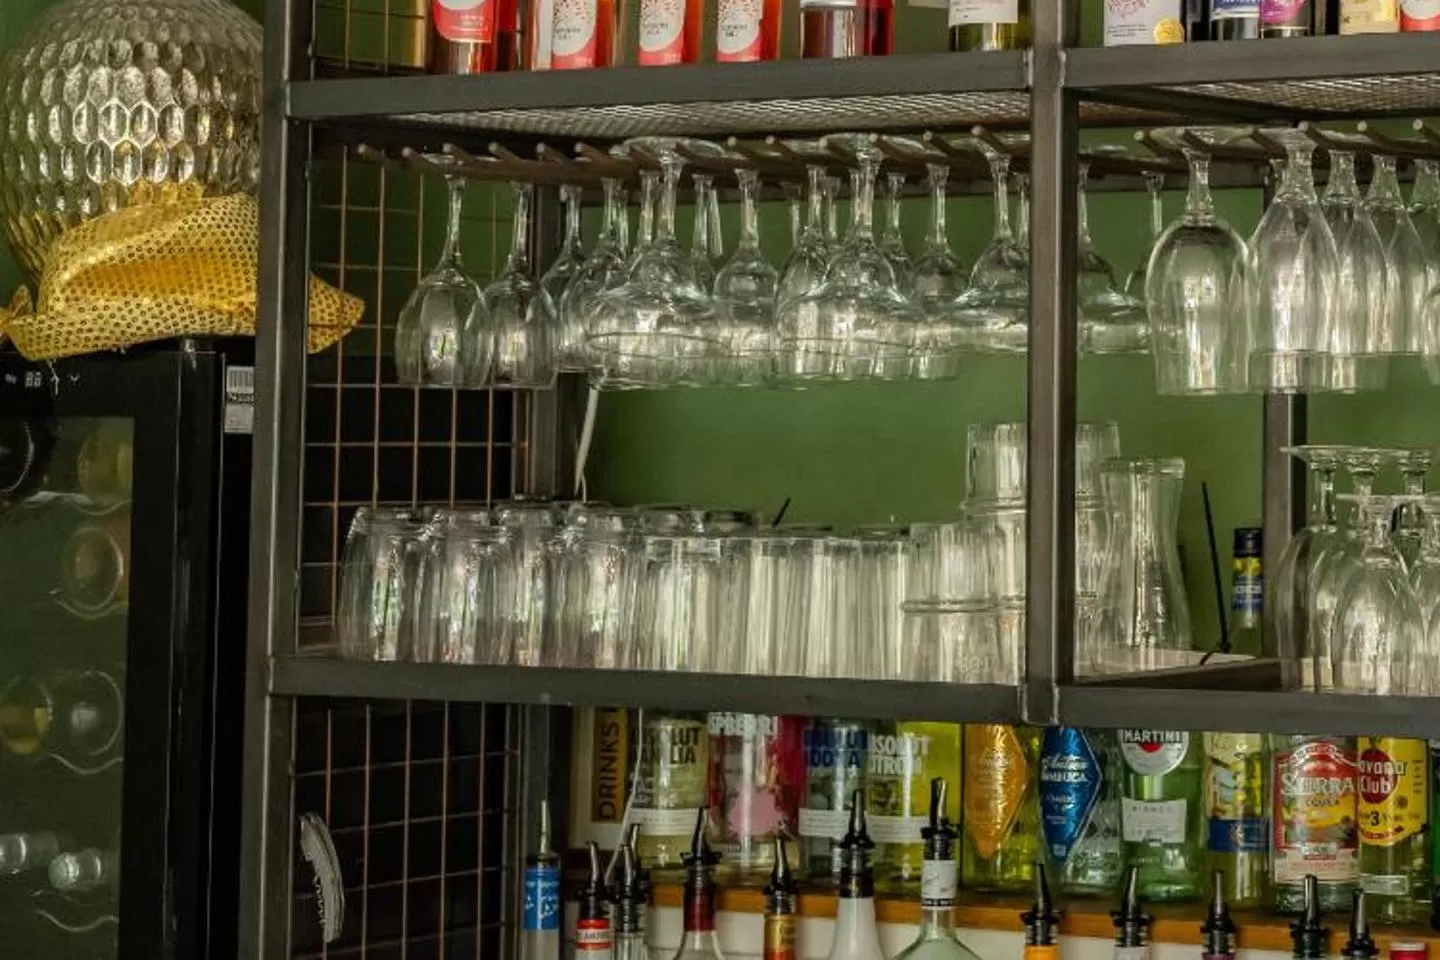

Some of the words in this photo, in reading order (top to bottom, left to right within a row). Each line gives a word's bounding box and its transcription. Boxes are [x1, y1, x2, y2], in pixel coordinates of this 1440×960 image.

[1123, 729, 1182, 742] MARTINI
[598, 721, 620, 820] DRINKS
[1359, 759, 1408, 776] avana
[1280, 772, 1355, 797] SIERRA
[1369, 811, 1380, 827] 3
